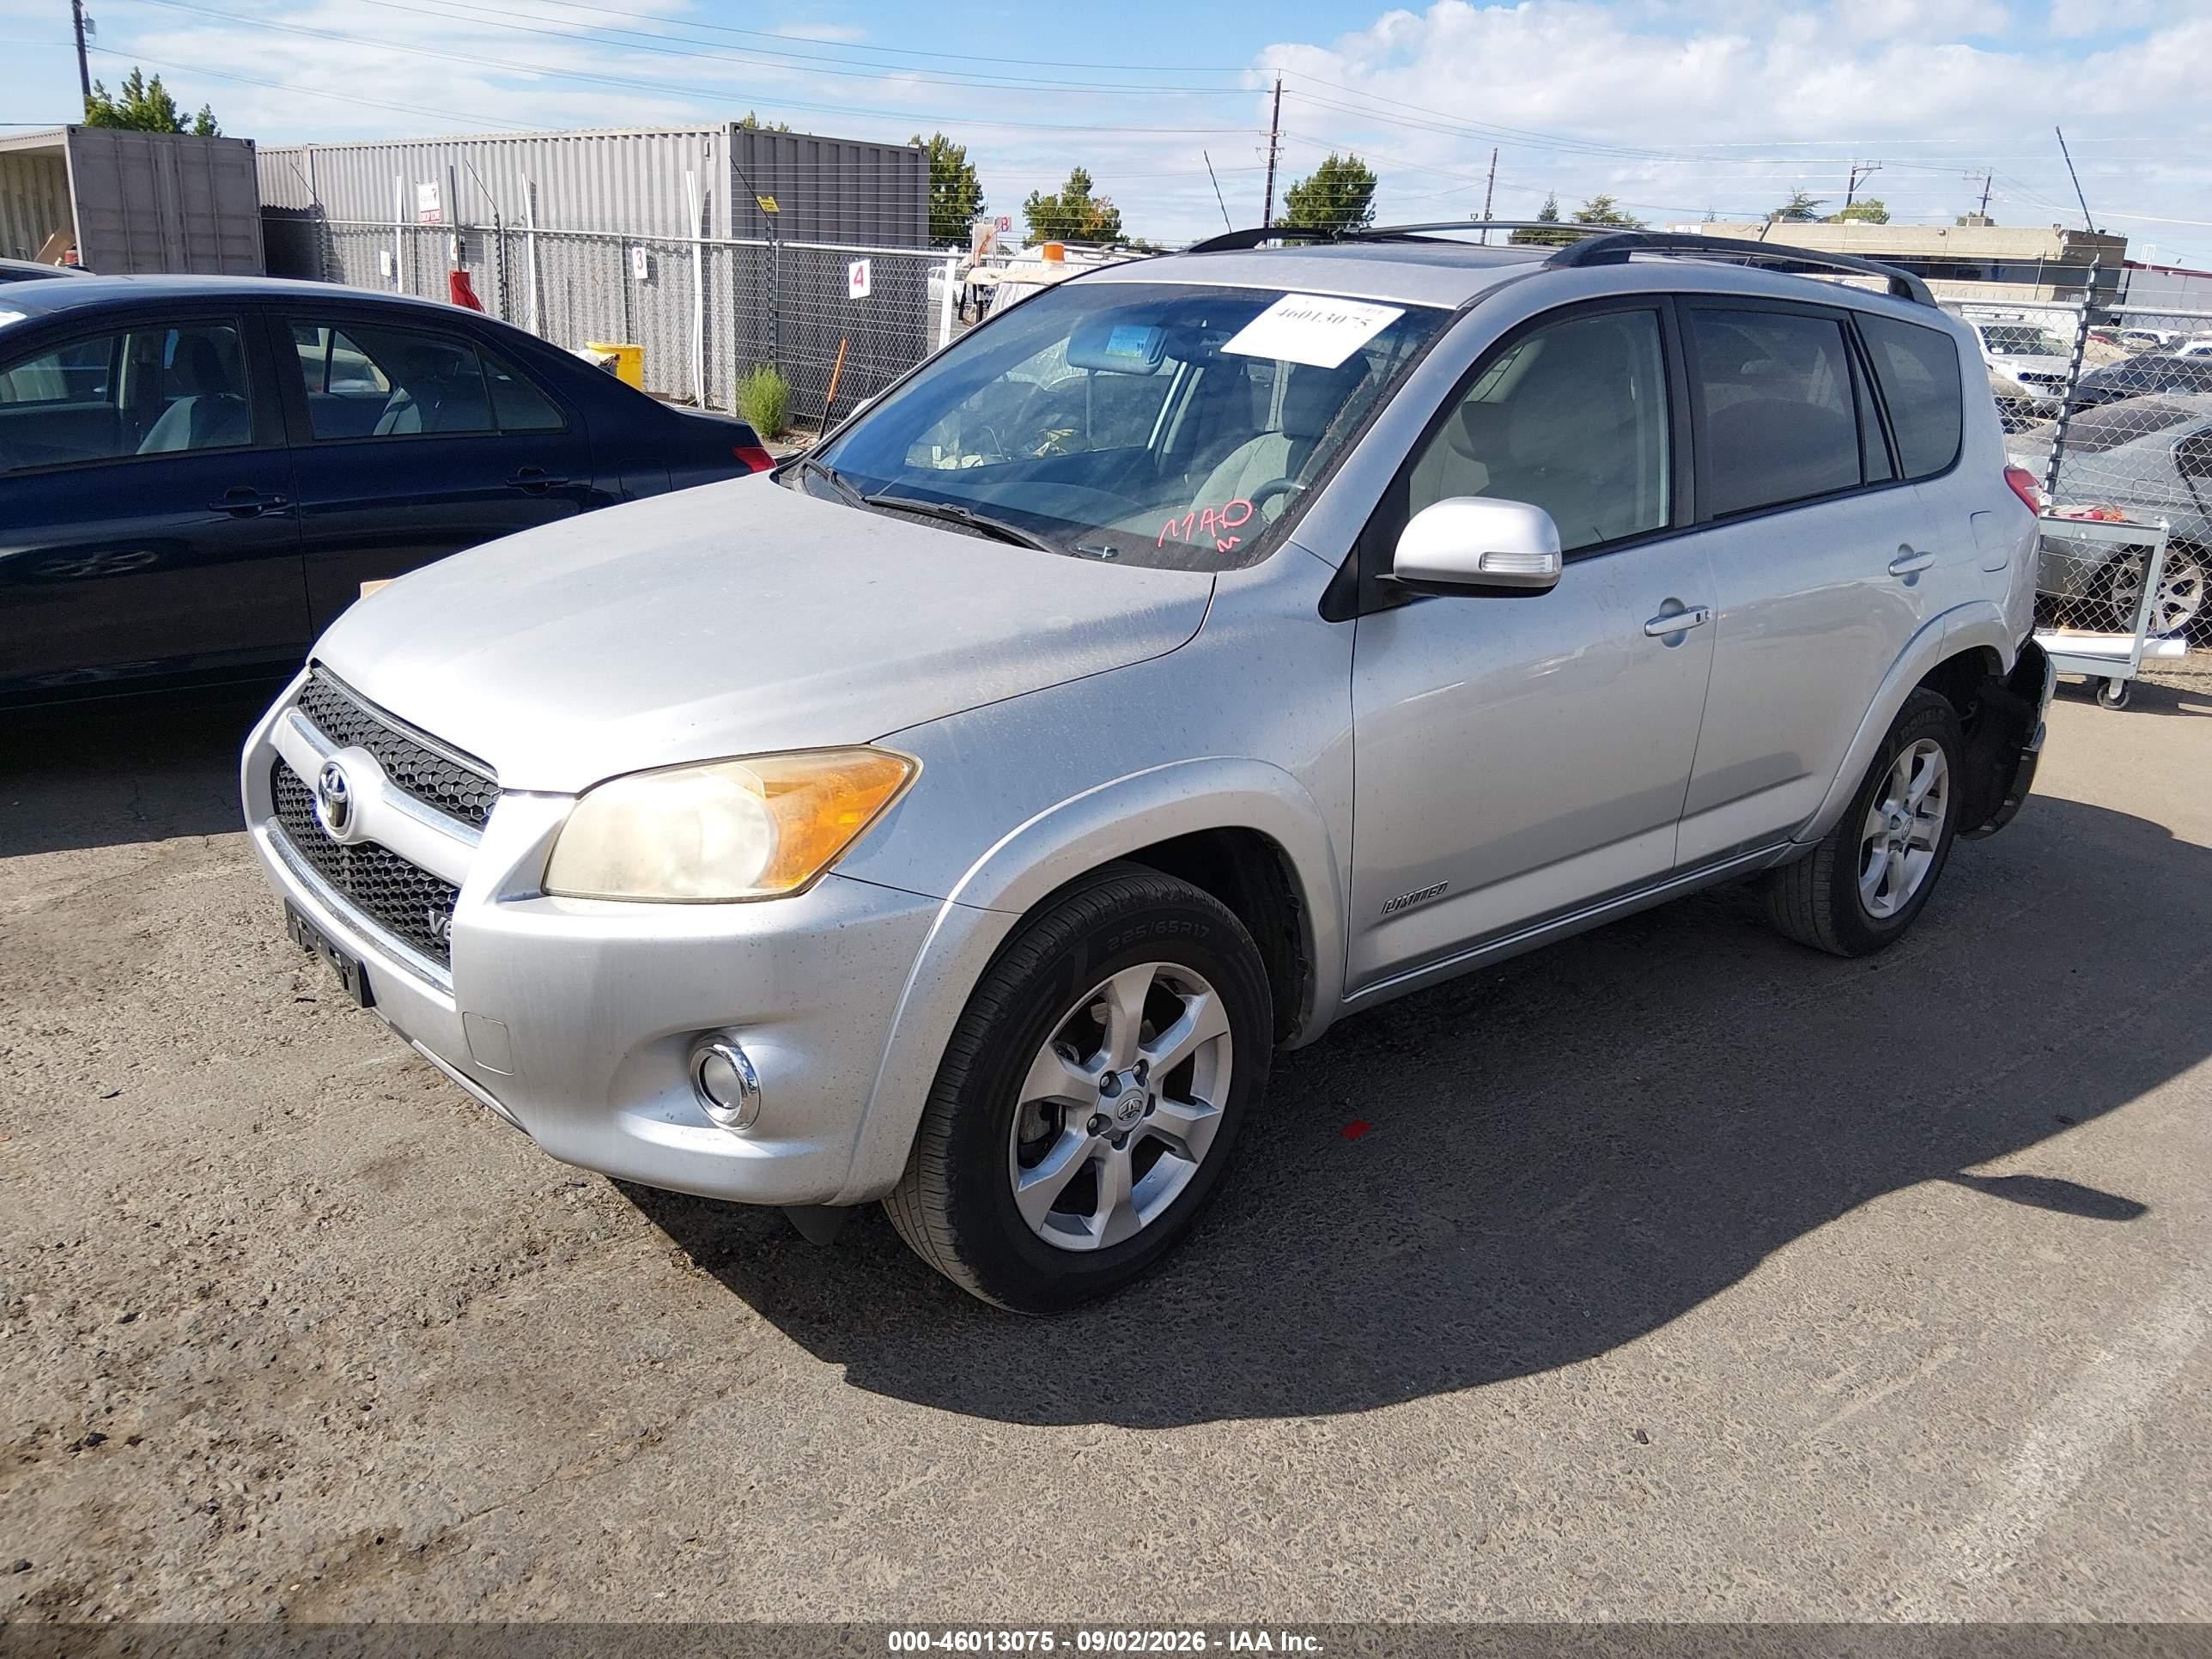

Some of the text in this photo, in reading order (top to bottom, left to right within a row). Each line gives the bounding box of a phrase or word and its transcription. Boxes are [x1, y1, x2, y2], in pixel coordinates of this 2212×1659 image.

[635, 249, 644, 270] 3
[854, 264, 864, 288] 4
[1381, 880, 1449, 915] LIMITED
[1107, 919, 1210, 951] 225/65R17
